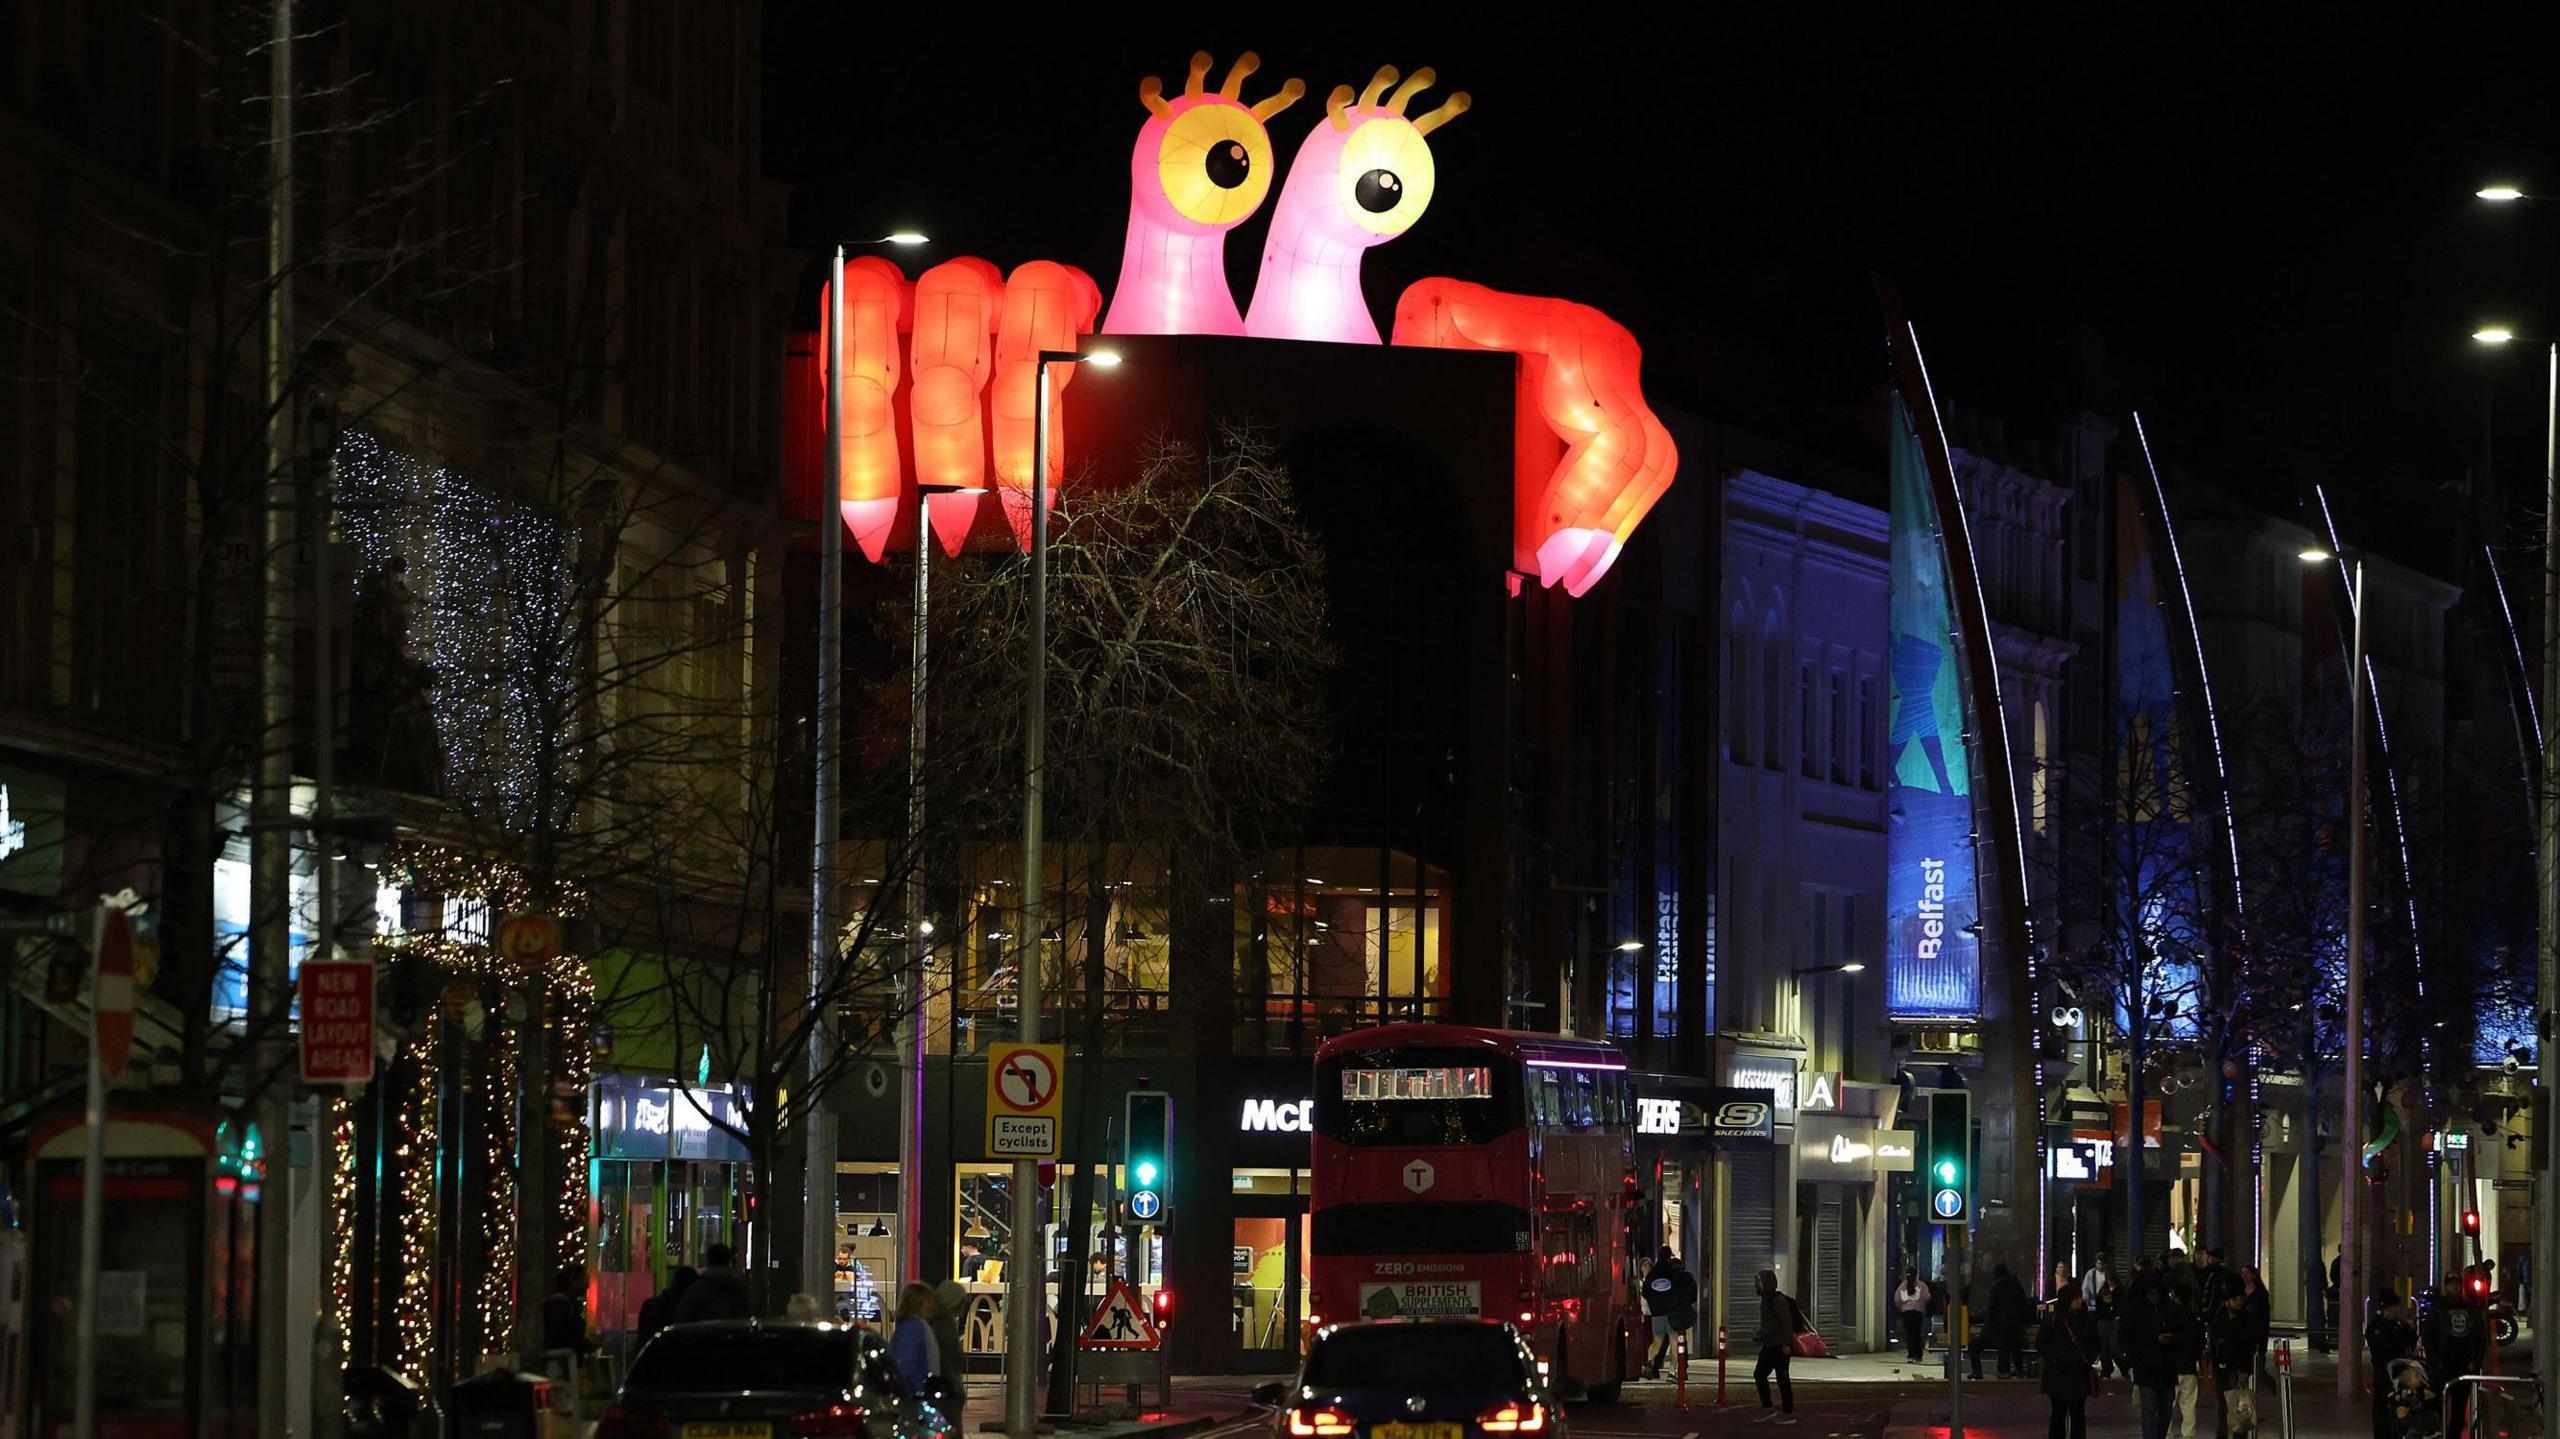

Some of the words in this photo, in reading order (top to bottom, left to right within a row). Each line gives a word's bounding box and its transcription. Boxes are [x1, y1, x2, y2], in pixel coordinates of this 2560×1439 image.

[1918, 857, 1945, 959] Belfast
[317, 972, 358, 992] NEW
[313, 997, 361, 1018] ROAD
[306, 1022, 369, 1044] LAYOUT
[310, 1048, 366, 1070] AHEAD
[1001, 1121, 1047, 1135] Except
[1714, 1129, 1768, 1137] SKECHERS
[999, 1136, 1048, 1149] cyclists
[1411, 1168, 1426, 1187] T
[1374, 1262, 1416, 1275] ZERO
[1416, 1263, 1465, 1273] EMISSIONS
[1405, 1285, 1467, 1297] BRITISH
[1401, 1296, 1473, 1308] SUPPLEMENTS
